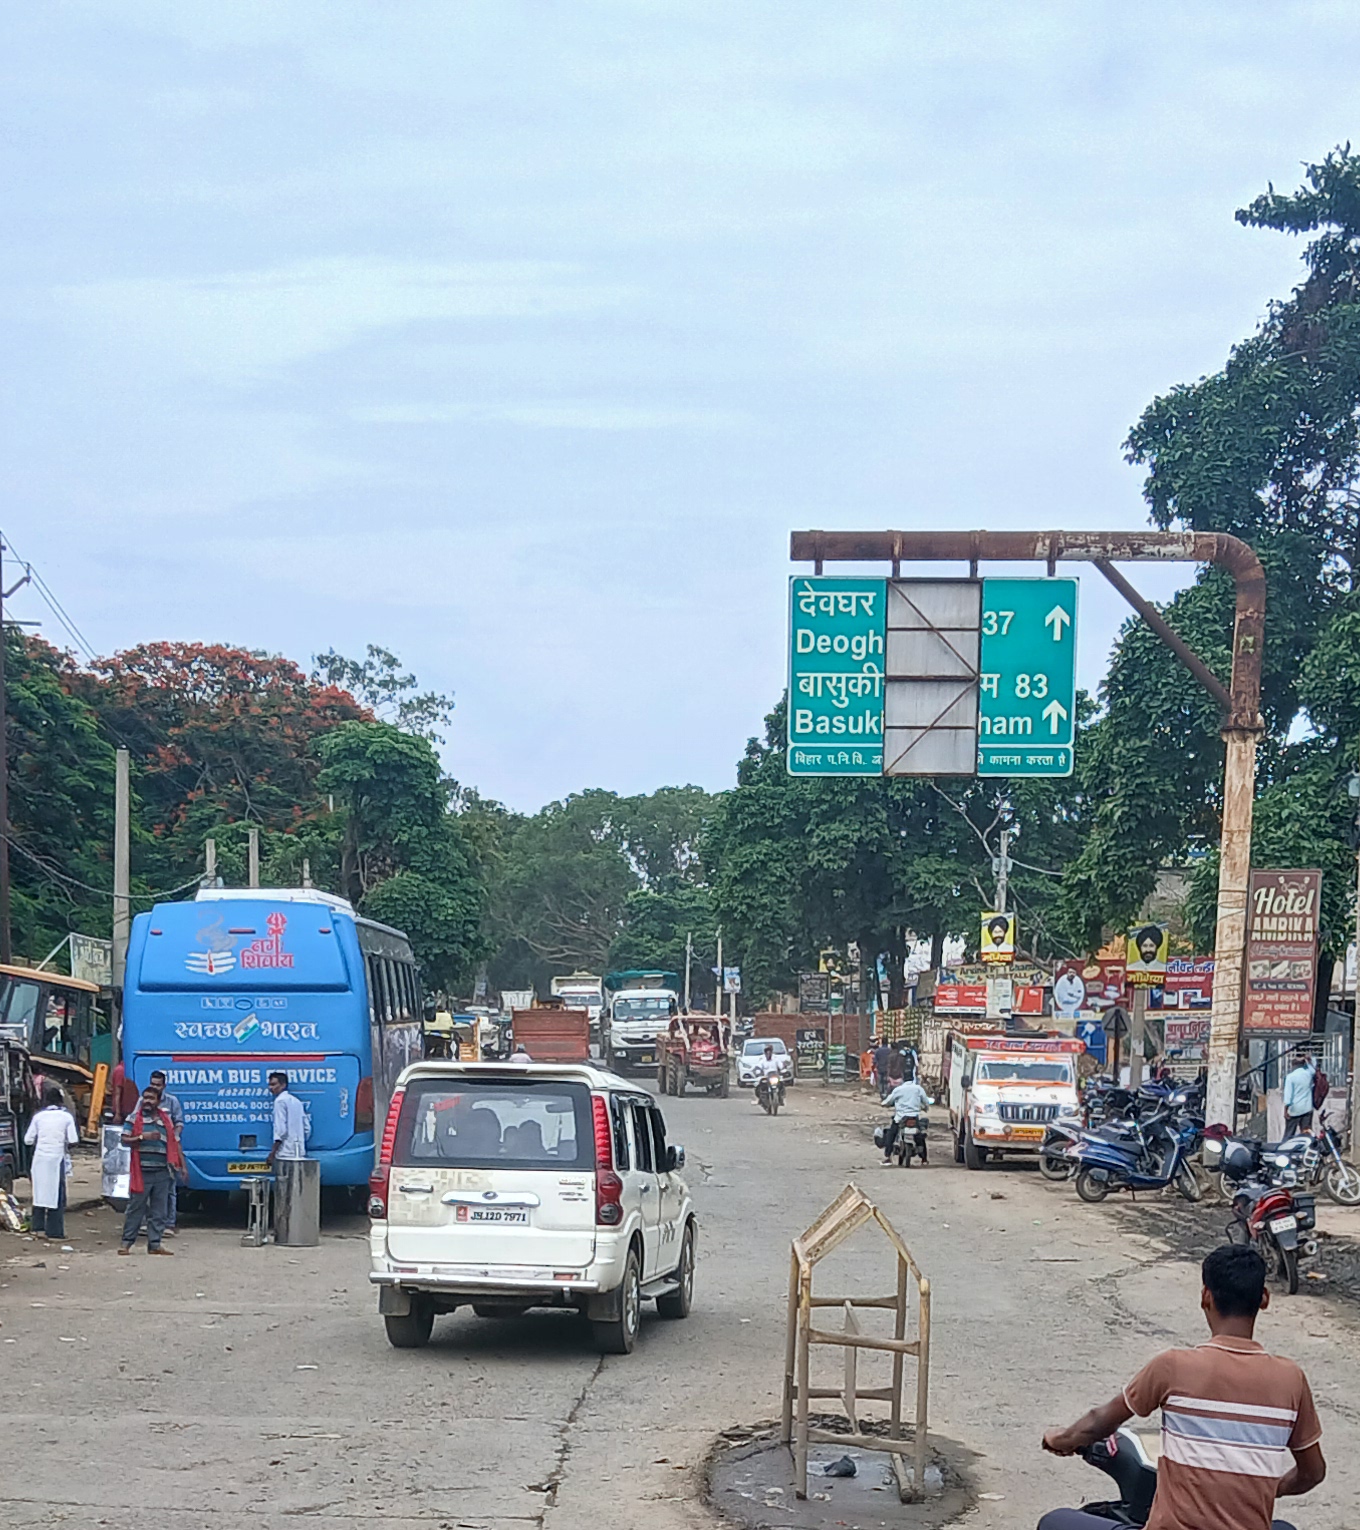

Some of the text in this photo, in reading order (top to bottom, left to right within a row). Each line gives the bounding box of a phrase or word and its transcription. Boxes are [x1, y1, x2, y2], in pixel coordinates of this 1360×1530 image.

[797, 581, 877, 617] देवघर
[796, 628, 884, 660] Deogh
[796, 662, 886, 708] बासुकी
[1015, 673, 1048, 698] 83
[979, 714, 1033, 735] ham
[795, 751, 822, 766] बिहार
[1253, 887, 1316, 916] Hotel
[1251, 916, 1314, 942] AMBIKA
[174, 1021, 321, 1041] स्वच्छ भारत
[227, 1069, 261, 1084] BUS
[266, 1068, 337, 1083] SRVICE
[503, 1212, 527, 1222] 7971
